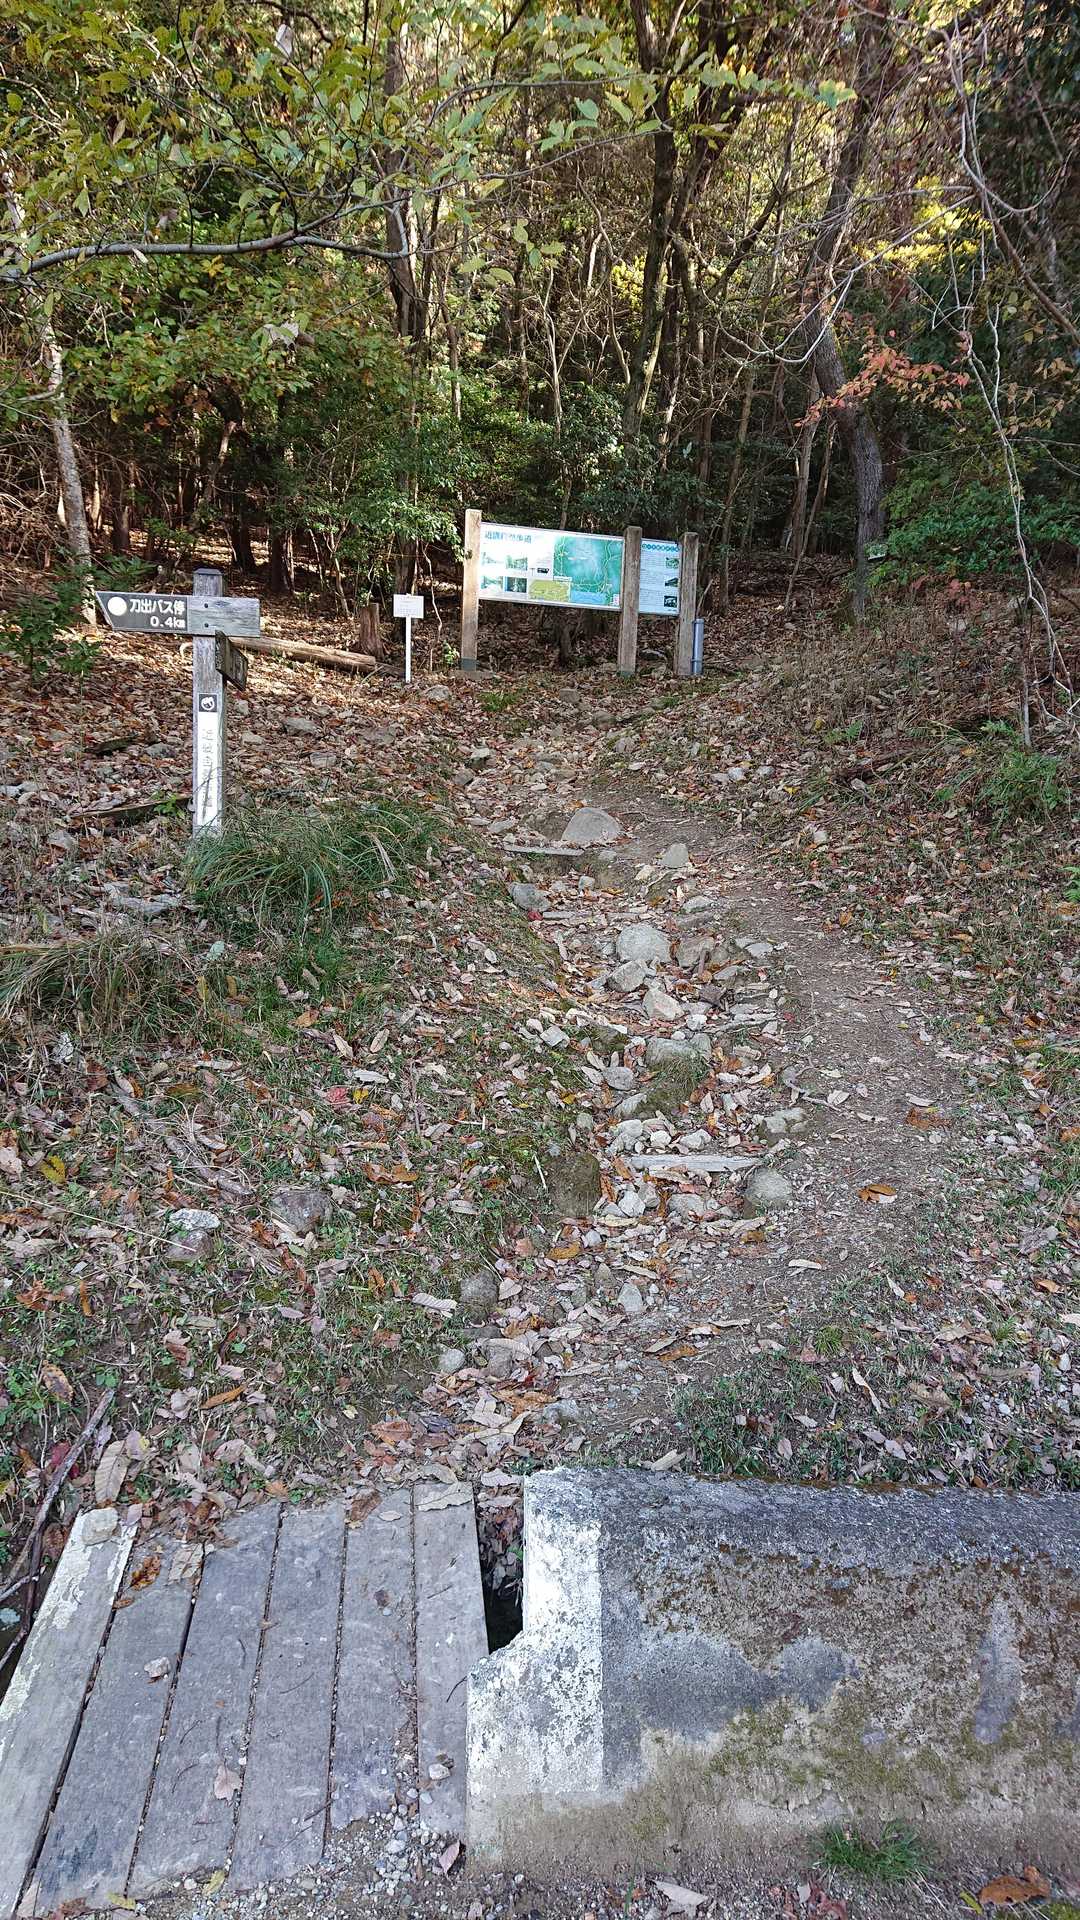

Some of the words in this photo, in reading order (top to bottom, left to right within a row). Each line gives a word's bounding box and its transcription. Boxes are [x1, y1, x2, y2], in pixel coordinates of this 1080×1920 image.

[129, 598, 185, 615] 刀出バス停
[150, 616, 186, 628] 0.4km
